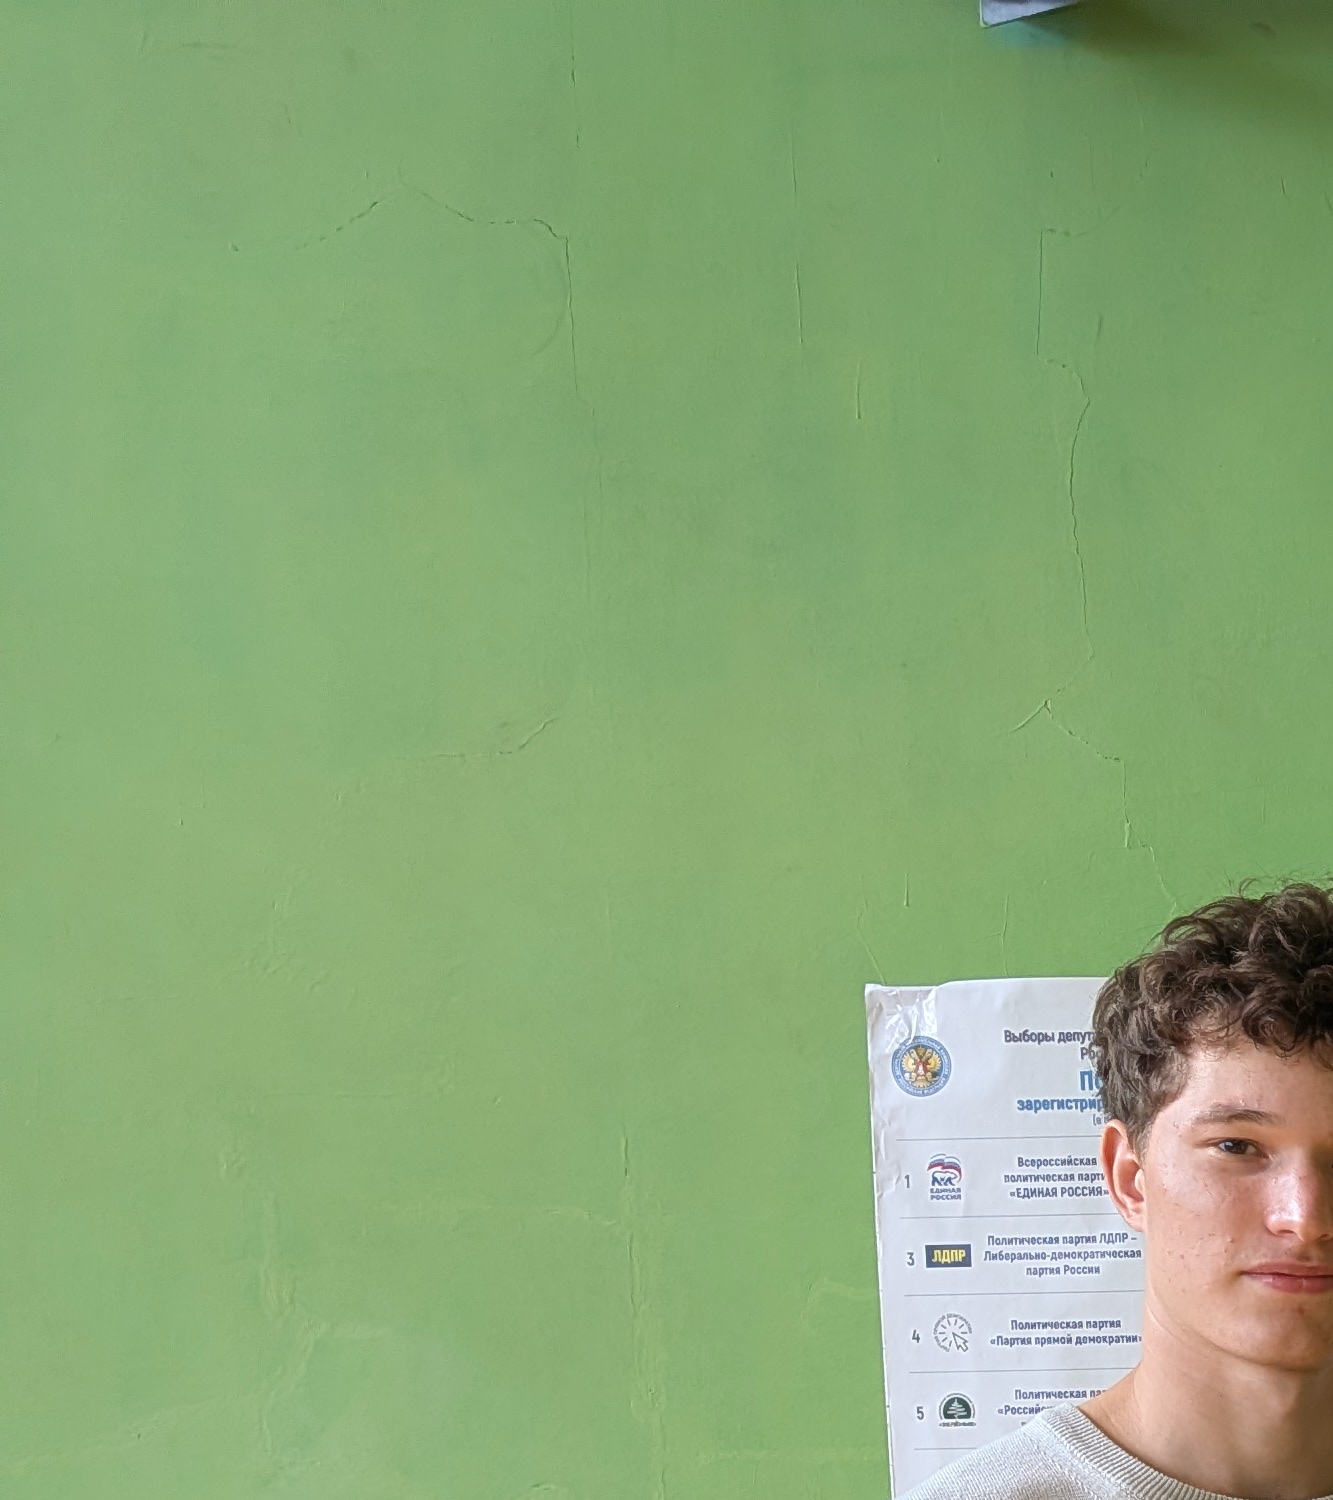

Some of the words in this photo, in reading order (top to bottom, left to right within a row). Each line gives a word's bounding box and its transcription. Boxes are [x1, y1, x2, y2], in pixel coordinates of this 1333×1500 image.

[1004, 1029, 1055, 1045] Выборы
[1058, 1031, 1094, 1045] депут
[1017, 1099, 1104, 1114] зарегистрир
[1017, 1155, 1097, 1169] Всероссийская
[904, 1175, 910, 1188] 1
[1004, 1173, 1075, 1183] политическая
[1078, 1172, 1105, 1184] парти
[1009, 1187, 1058, 1199] «ЕДИНАЯ
[1060, 1186, 1109, 1198] РОССИЯ»
[987, 1235, 1059, 1246] Политическая
[1062, 1235, 1097, 1246] партия
[1099, 1232, 1128, 1244] ЛДПР
[906, 1252, 915, 1266] 3
[931, 1249, 966, 1264] ЛДПР
[983, 1249, 1142, 1262] Либерально-демократическая
[1026, 1266, 1060, 1277] партия
[1063, 1265, 1100, 1275] России
[1010, 1320, 1083, 1331] Политическая
[1085, 1320, 1121, 1331] партия
[911, 1329, 920, 1343] 4
[990, 1335, 1032, 1347] «Партия
[1034, 1334, 1072, 1347] прямой
[1014, 1389, 1087, 1400] Политическая
[916, 1406, 924, 1420] 5
[998, 1404, 1052, 1416] «Россий
